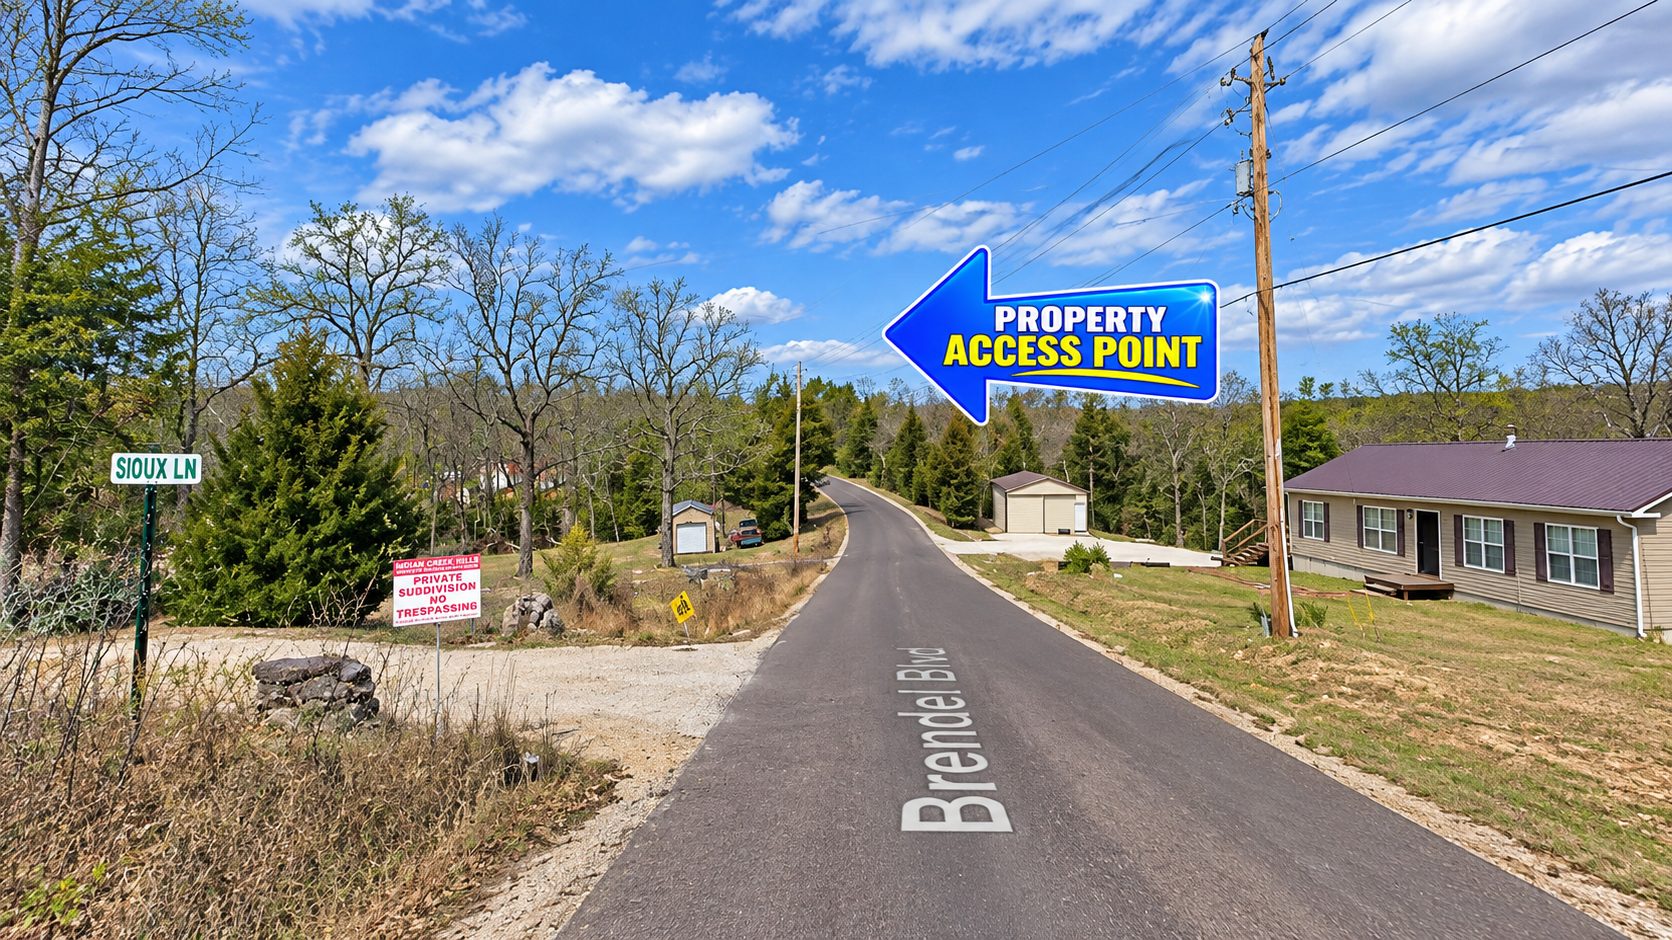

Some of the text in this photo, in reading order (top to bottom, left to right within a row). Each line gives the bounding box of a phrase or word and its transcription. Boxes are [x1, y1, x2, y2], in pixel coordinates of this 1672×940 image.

[116, 456, 197, 480] SIOUX LN
[413, 572, 463, 585] PRIVATE
[429, 594, 447, 605] NO
[396, 601, 478, 619] TRESPASSING
